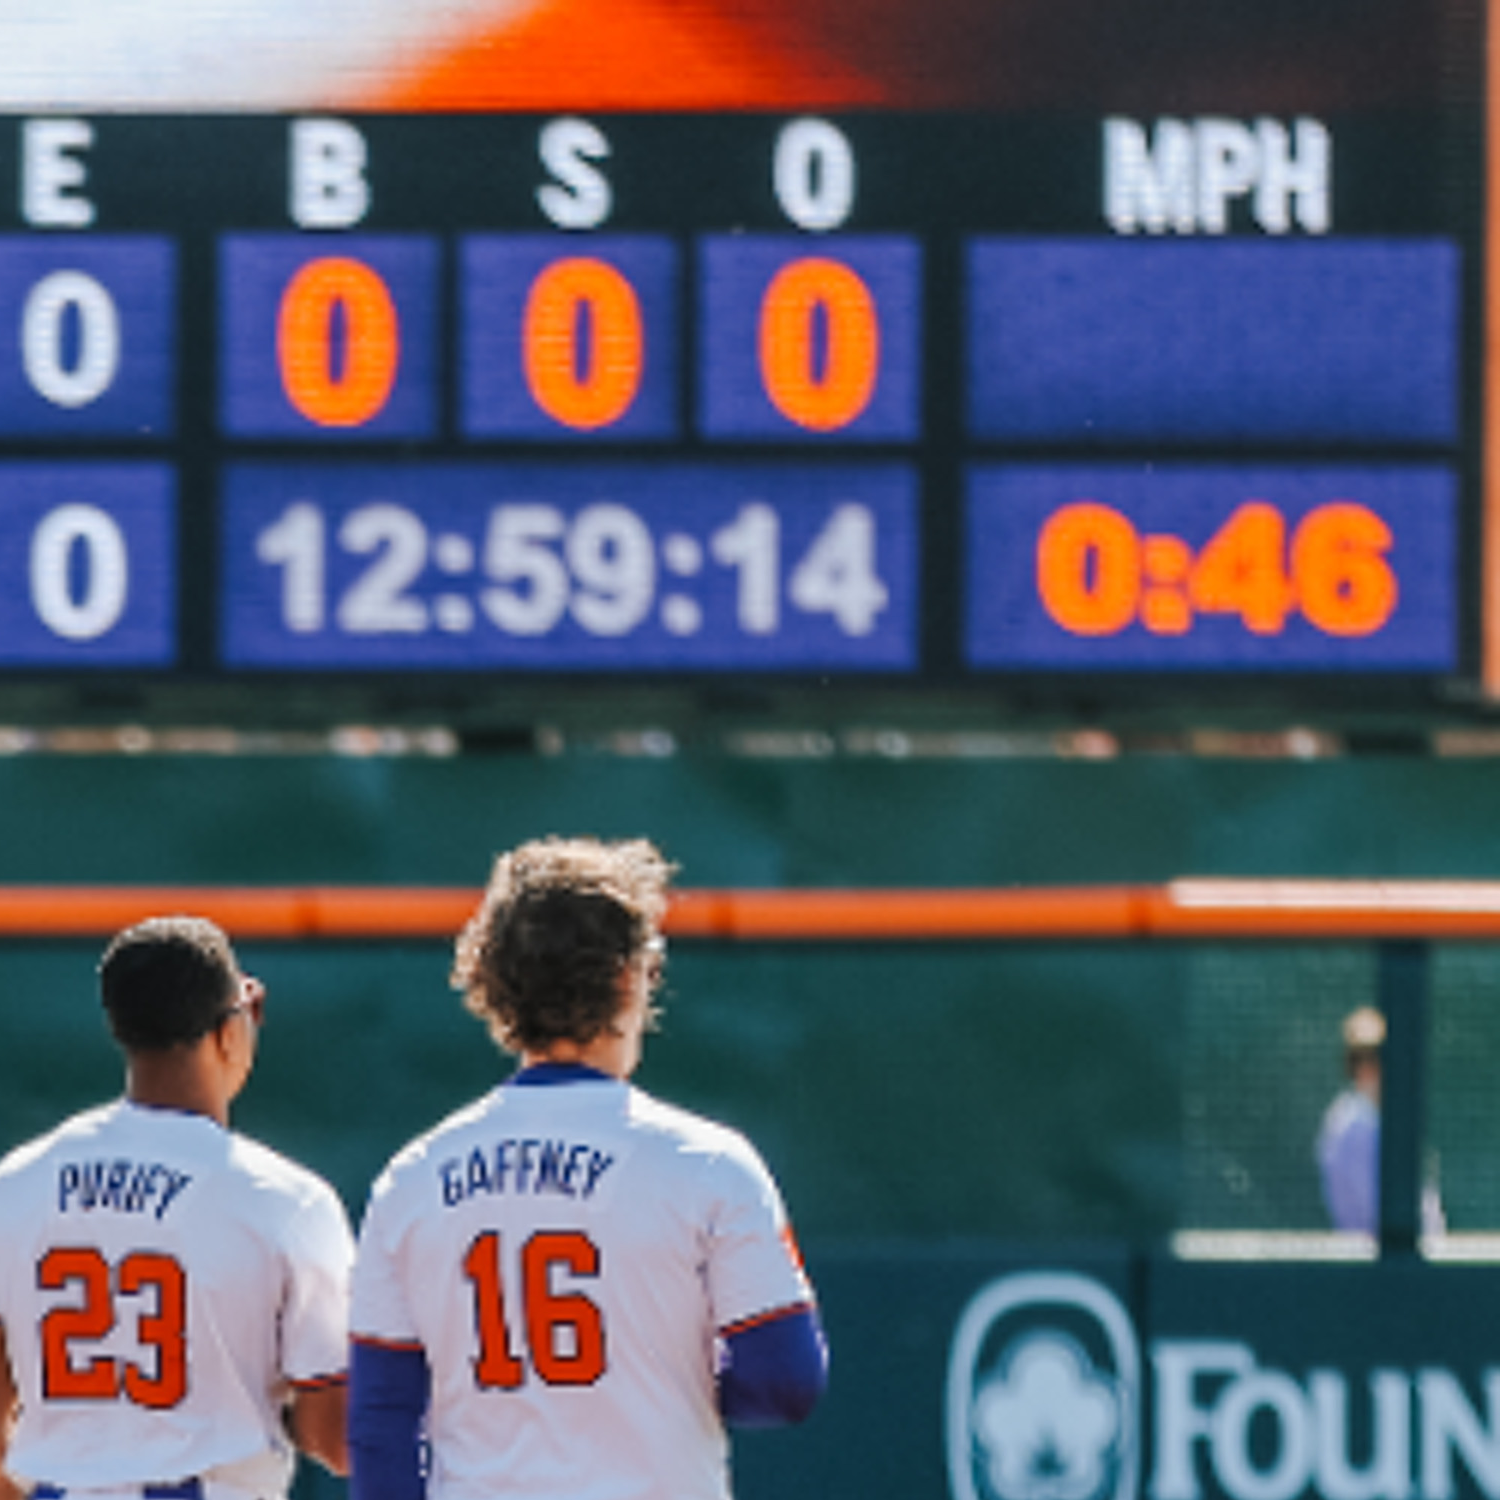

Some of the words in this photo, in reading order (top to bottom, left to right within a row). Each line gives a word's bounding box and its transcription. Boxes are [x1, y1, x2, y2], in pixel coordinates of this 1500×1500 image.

[22, 118, 95, 227] E
[290, 118, 370, 229] B
[537, 117, 612, 229] S
[1103, 117, 1332, 234] MPH
[20, 269, 121, 408] 0
[275, 256, 400, 428] 0
[521, 256, 644, 431] 0
[758, 256, 880, 432] 0
[28, 502, 129, 641] 0
[257, 503, 889, 637] 12:59:14
[1035, 501, 1399, 637] 0:46
[58, 1160, 193, 1219] PURIFY
[438, 1139, 614, 1207] GAFFNEY
[36, 1247, 188, 1410] 23
[461, 1230, 608, 1388] 16
